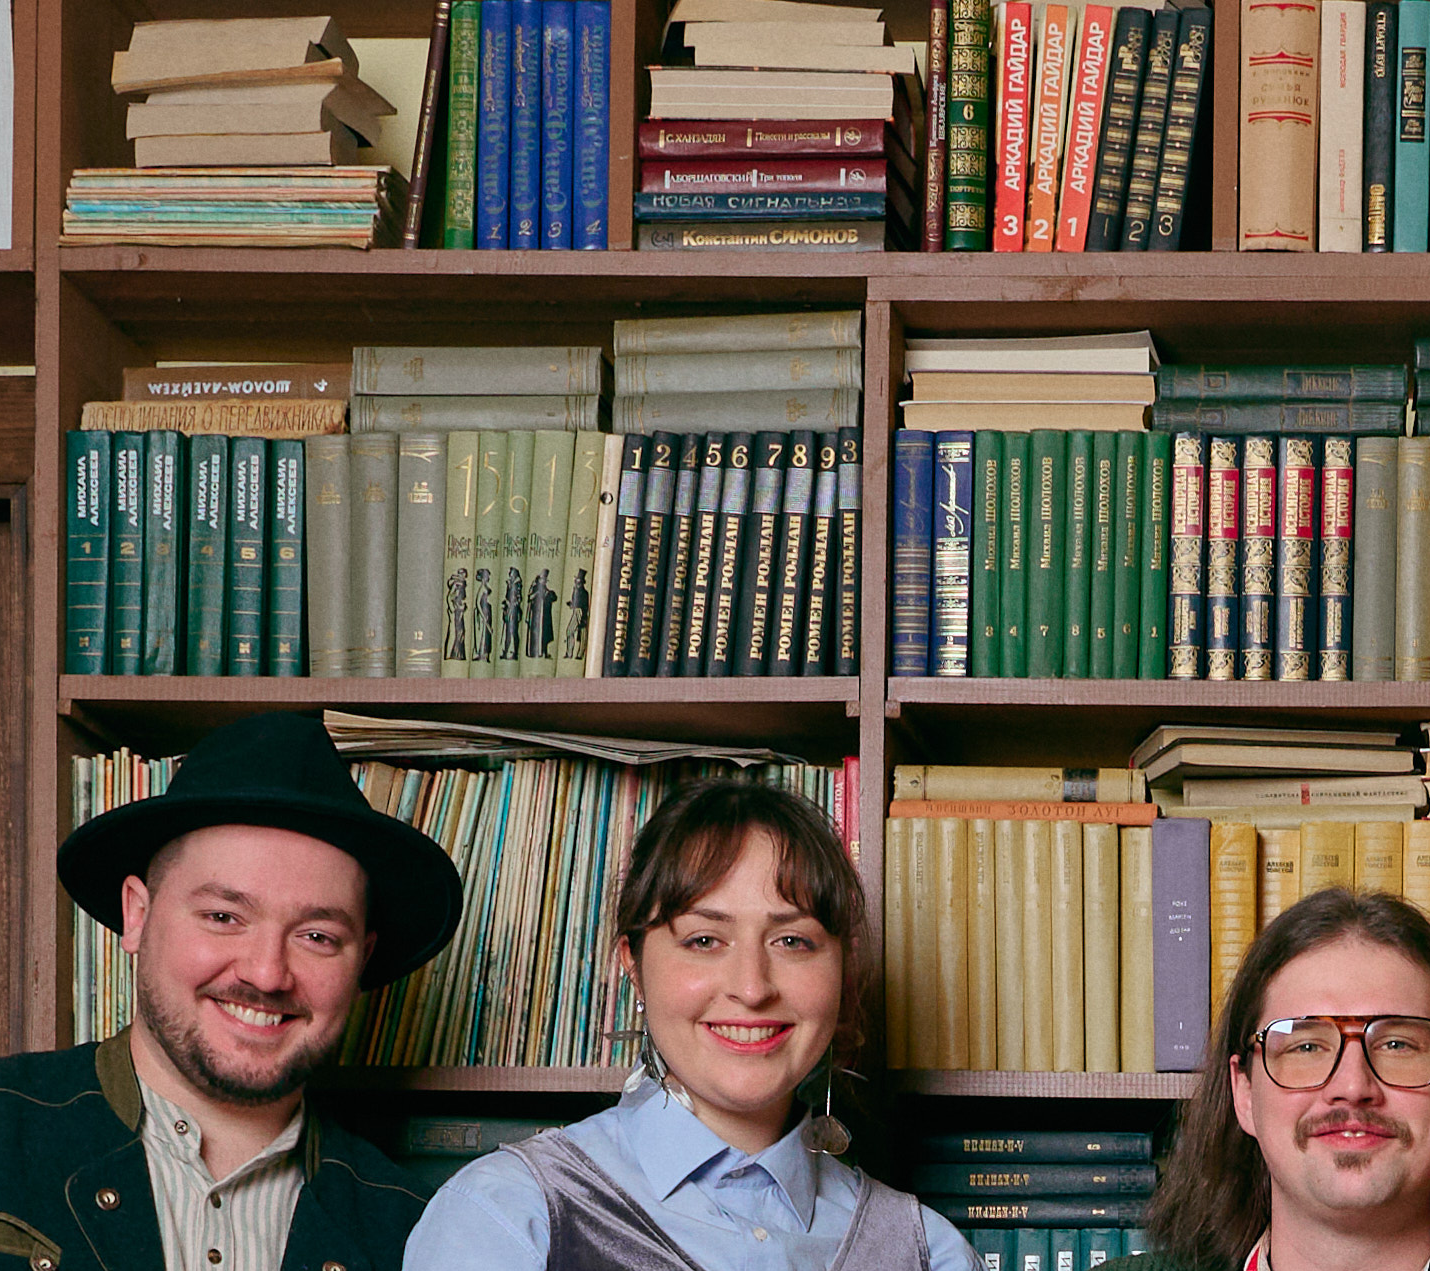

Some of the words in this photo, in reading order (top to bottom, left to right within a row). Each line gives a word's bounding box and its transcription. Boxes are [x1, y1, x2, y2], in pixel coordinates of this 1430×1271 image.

[1008, 17, 1029, 93] ГАЙДАР
[1044, 22, 1064, 97] ГАЙДАР
[1082, 21, 1105, 96] ГАЙДАР
[1004, 99, 1024, 192] АРКАДИЙ
[1037, 103, 1059, 195] АРКАДИЙ
[1070, 101, 1096, 194] АРКАДИЙ
[682, 229, 768, 247] Константин
[769, 228, 859, 245] СИМОНОВ
[1002, 215, 1019, 236] 3
[1033, 219, 1049, 239] 2
[1067, 217, 1078, 237] 1
[1128, 221, 1144, 242] 2
[1158, 215, 1173, 236] 3
[88, 404, 197, 431] ВОСПОМИНАНИЯ
[203, 406, 213, 431] О
[220, 404, 336, 433] ПЕРЕДВИЖНИКАХ
[148, 380, 292, 395] ШОЛОМ-АЛЕЙХЕМ
[118, 450, 127, 511] МИХАИЛ
[631, 447, 643, 470] 1
[654, 444, 671, 467] 2
[682, 446, 698, 468] 4
[705, 443, 722, 467] 5
[730, 445, 748, 468] 6
[768, 444, 783, 467] 7
[792, 444, 807, 468] 8
[820, 446, 836, 469] 9
[841, 439, 857, 463] 3
[77, 456, 87, 518] МИХАИЛ
[90, 450, 99, 526] АЛЕКСЕЕВ
[128, 450, 138, 527] АЛЕКСЕЕВ
[153, 454, 163, 515] МИХАИЛ
[163, 455, 173, 530] АЛЕКСЕЕВ
[198, 460, 208, 520] МИХАИЛ
[209, 454, 220, 529] АЛЕКСЕЕВ
[237, 460, 247, 522] МИХАИЛ
[249, 454, 259, 530] АЛЕКСЕЕВ
[277, 457, 287, 520] МИХАИЛ
[287, 459, 297, 535] АЛЕКСЕЕВ
[985, 459, 997, 522] ШОЛОХОВ
[1010, 458, 1022, 522] ШОЛОХОВ
[1041, 456, 1053, 520] ШОЛОХОВ
[1073, 456, 1085, 520] ШОЛОХОВ
[1099, 459, 1111, 523] ШОЛОХОВ
[1125, 455, 1137, 519] ШОЛОХОВ
[1152, 458, 1164, 522] ШОЛОХОВ
[1174, 468, 1187, 534] ВСЕМИРНАЯ
[1187, 475, 1200, 526] ИСТОРИЯ
[1210, 471, 1222, 537] ВСЕМИРНАЯ
[1223, 479, 1236, 529] ИСТОРИЯ
[1246, 468, 1259, 534] ВСЕМИРНАЯ
[1259, 477, 1272, 527] ИСТОРИЯ
[1285, 469, 1298, 536] ВСЕМИРНАЯ
[1298, 478, 1312, 528] ИСТОРИЯ
[1324, 470, 1337, 535] ВСЕМИРНАЯ
[1337, 478, 1350, 527] ИСТОРИЯ
[620, 516, 639, 591] РОЛЛАН
[645, 515, 664, 589] РОЛЛАН
[674, 516, 692, 590] РОЛЛАН
[696, 514, 715, 587] РОЛЛАН
[721, 516, 740, 590] РОЛЛАН
[757, 514, 775, 588] РОЛЛАН
[784, 515, 802, 589] РОЛЛАН
[812, 517, 830, 592] РОЛЛАН
[843, 512, 856, 586] РОЛЛАН
[613, 595, 630, 663] РОМЕН
[638, 592, 656, 661] РОМЕН
[666, 594, 684, 663] РОМЕН
[688, 591, 706, 659] РОМЕН
[714, 593, 732, 663] РОМЕН
[749, 592, 768, 661] РОМЕН
[778, 593, 795, 662] РОМЕН
[807, 594, 824, 664] РОМЕН
[841, 591, 855, 660] РОМЕН
